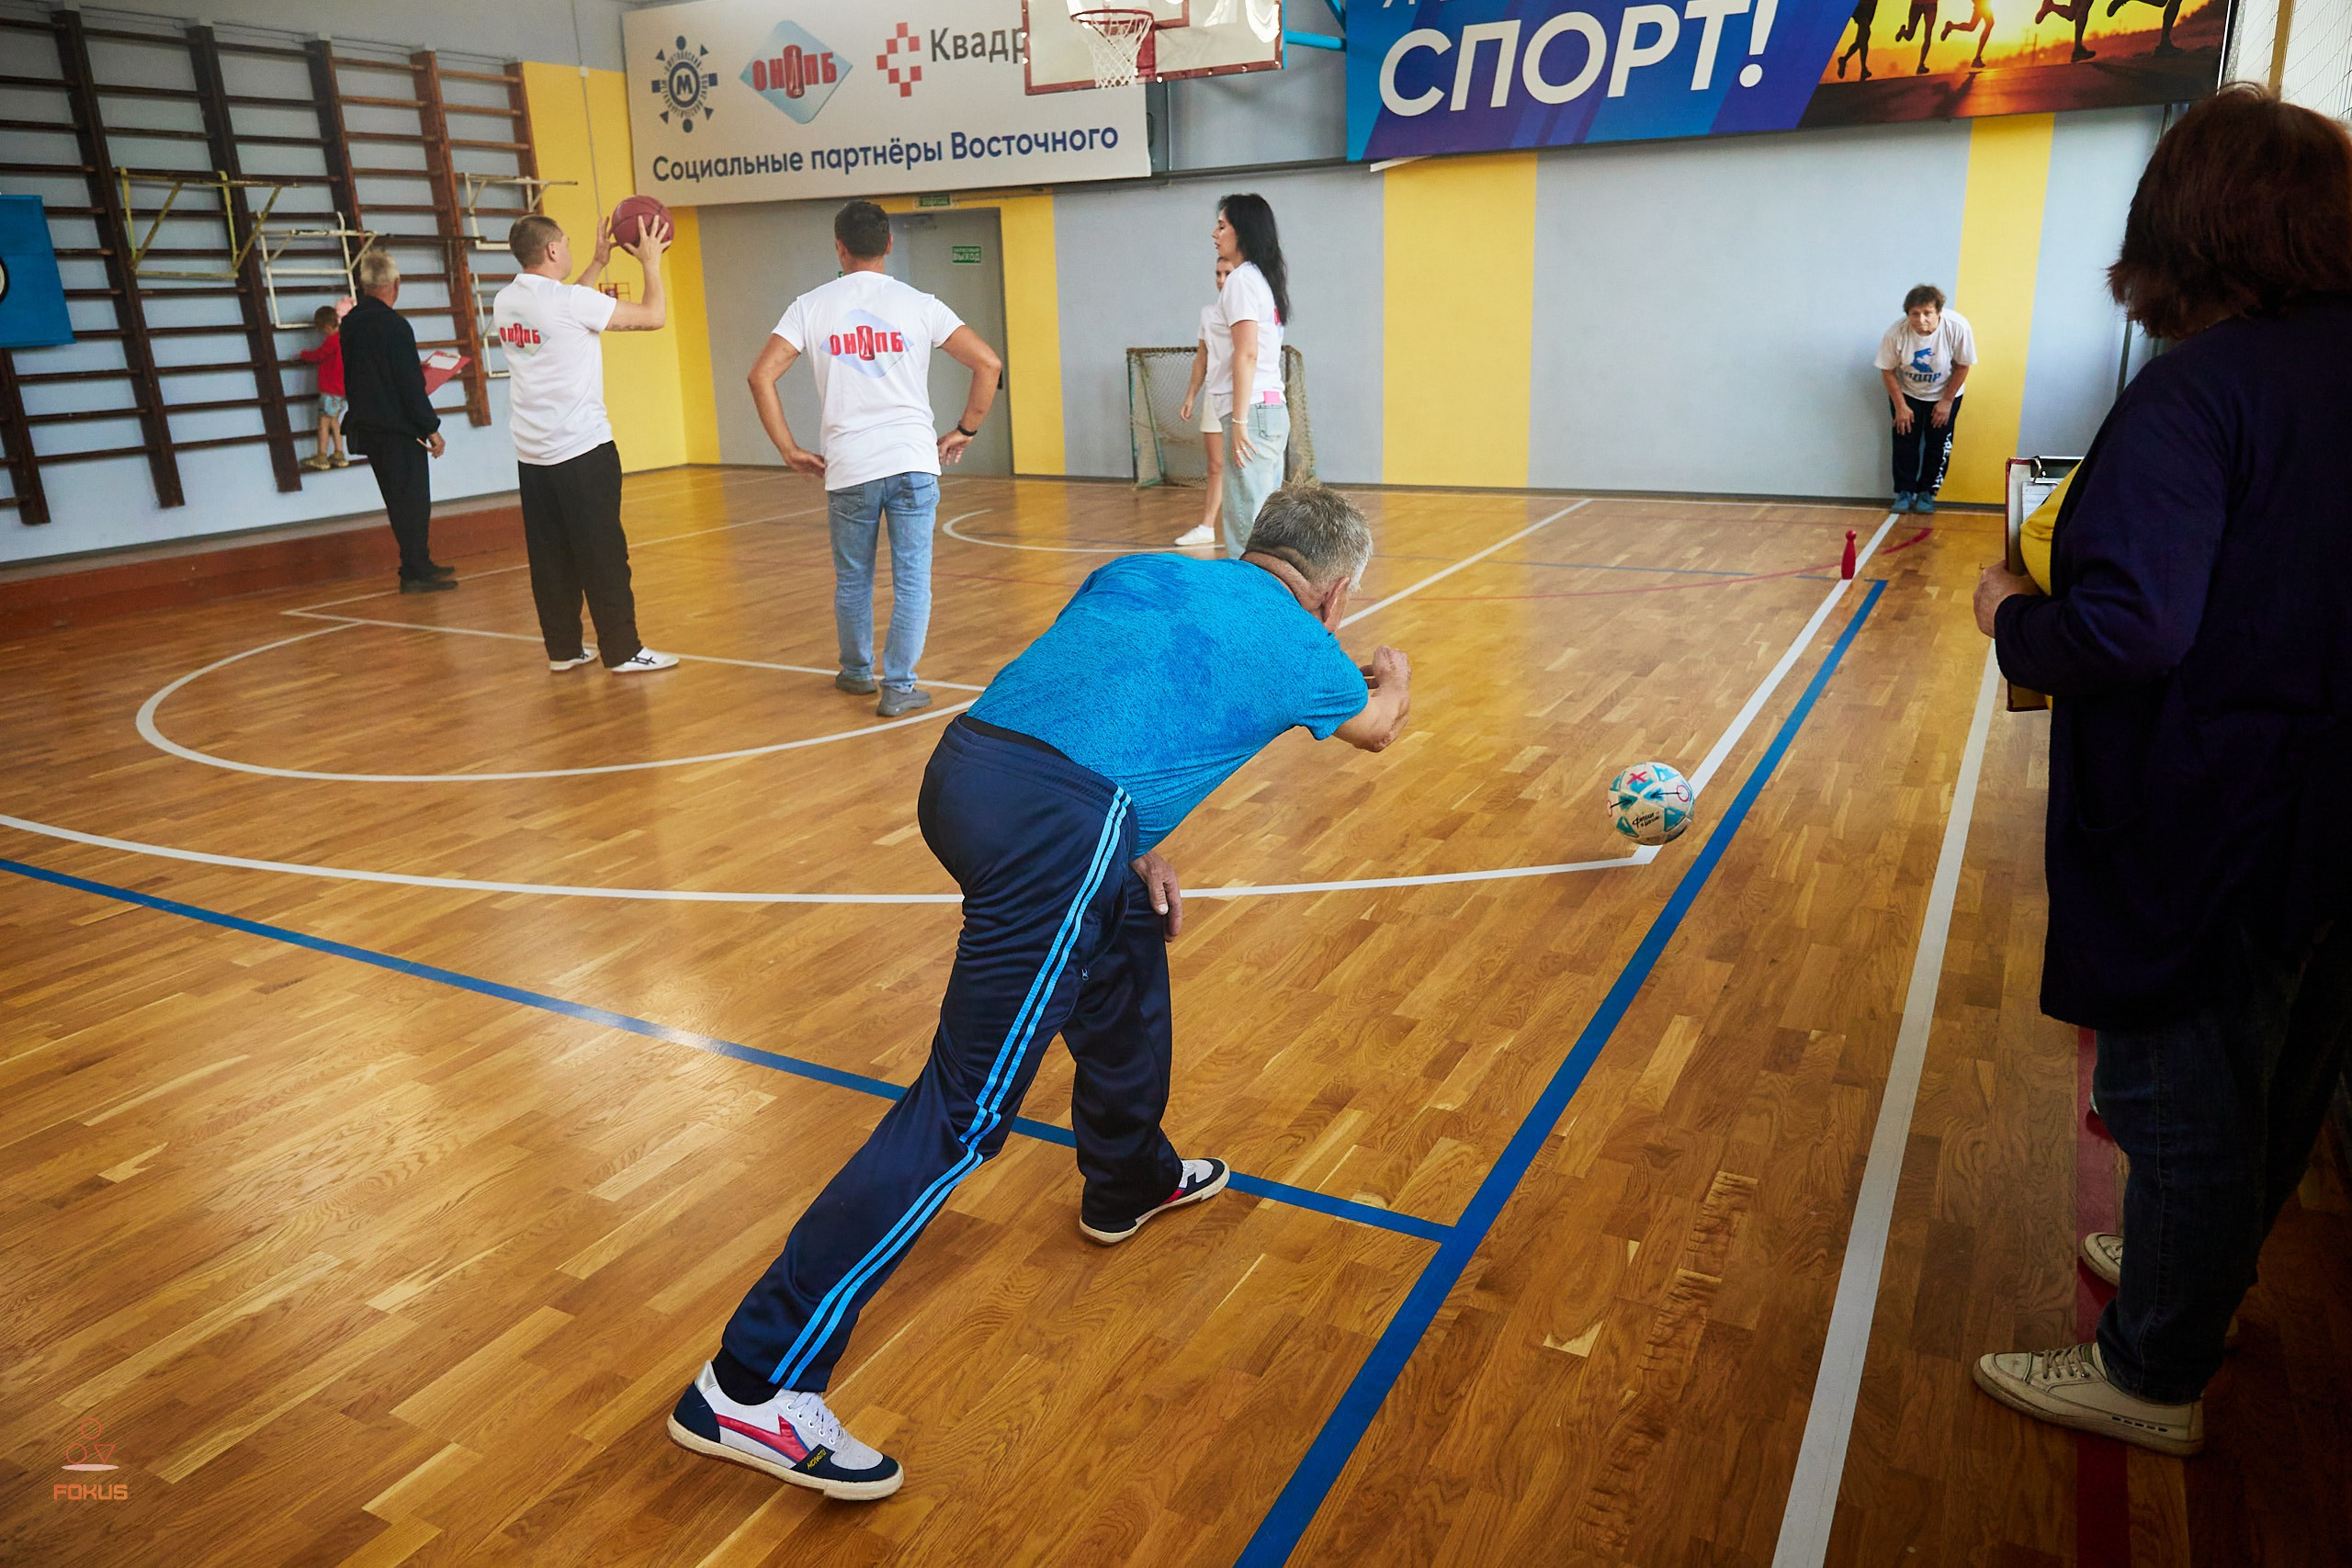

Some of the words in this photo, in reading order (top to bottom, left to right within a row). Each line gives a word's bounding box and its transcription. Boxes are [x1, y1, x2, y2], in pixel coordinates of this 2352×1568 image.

[1379, 0, 1778, 117] СПОРТ!
[652, 152, 804, 183] Социальные
[811, 137, 943, 175] партнёры
[950, 127, 1119, 160] Восточного
